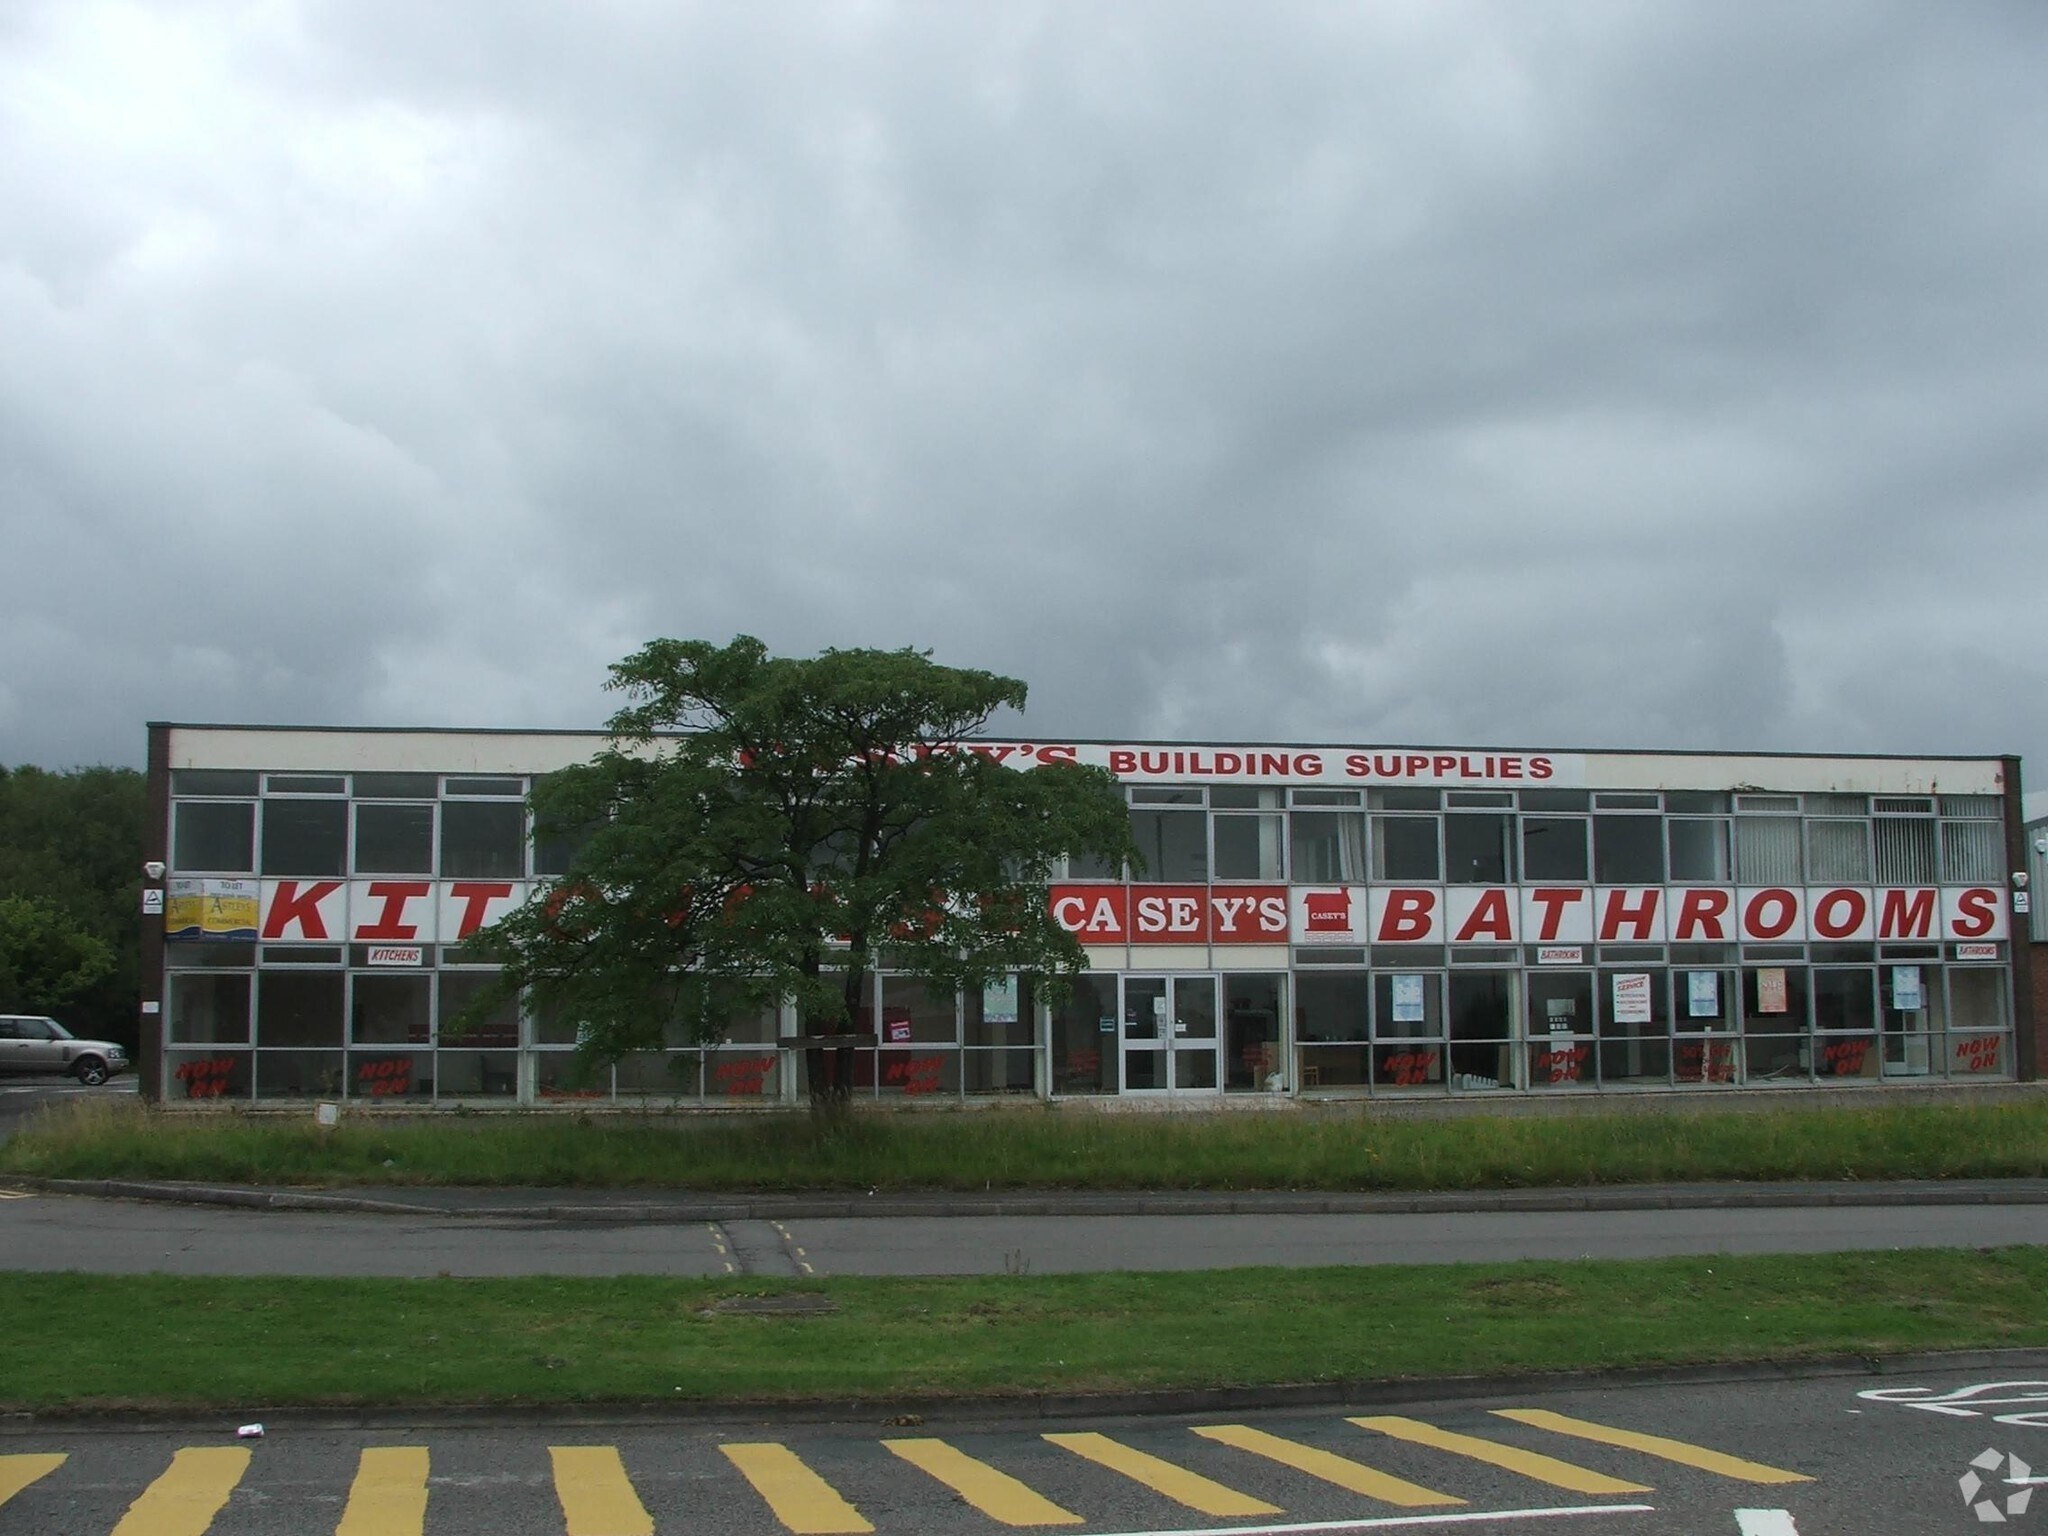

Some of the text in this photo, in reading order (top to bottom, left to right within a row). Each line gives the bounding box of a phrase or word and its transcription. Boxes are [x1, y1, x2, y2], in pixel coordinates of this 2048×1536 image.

[1110, 751, 1323, 776] BUILDING
[1345, 755, 1554, 779] SUPPLIES
[1311, 911, 1347, 920] CASEY'S
[1377, 887, 1998, 941] BATHROOMS
[371, 949, 420, 962] KITCHENS
[1538, 1046, 1589, 1068] NOW
[1824, 1039, 1871, 1061] NOW
[1956, 1036, 1999, 1057] NOW
[1384, 1052, 1436, 1071] NOW
[1835, 1056, 1863, 1077] ON
[1970, 1052, 1995, 1072] ON
